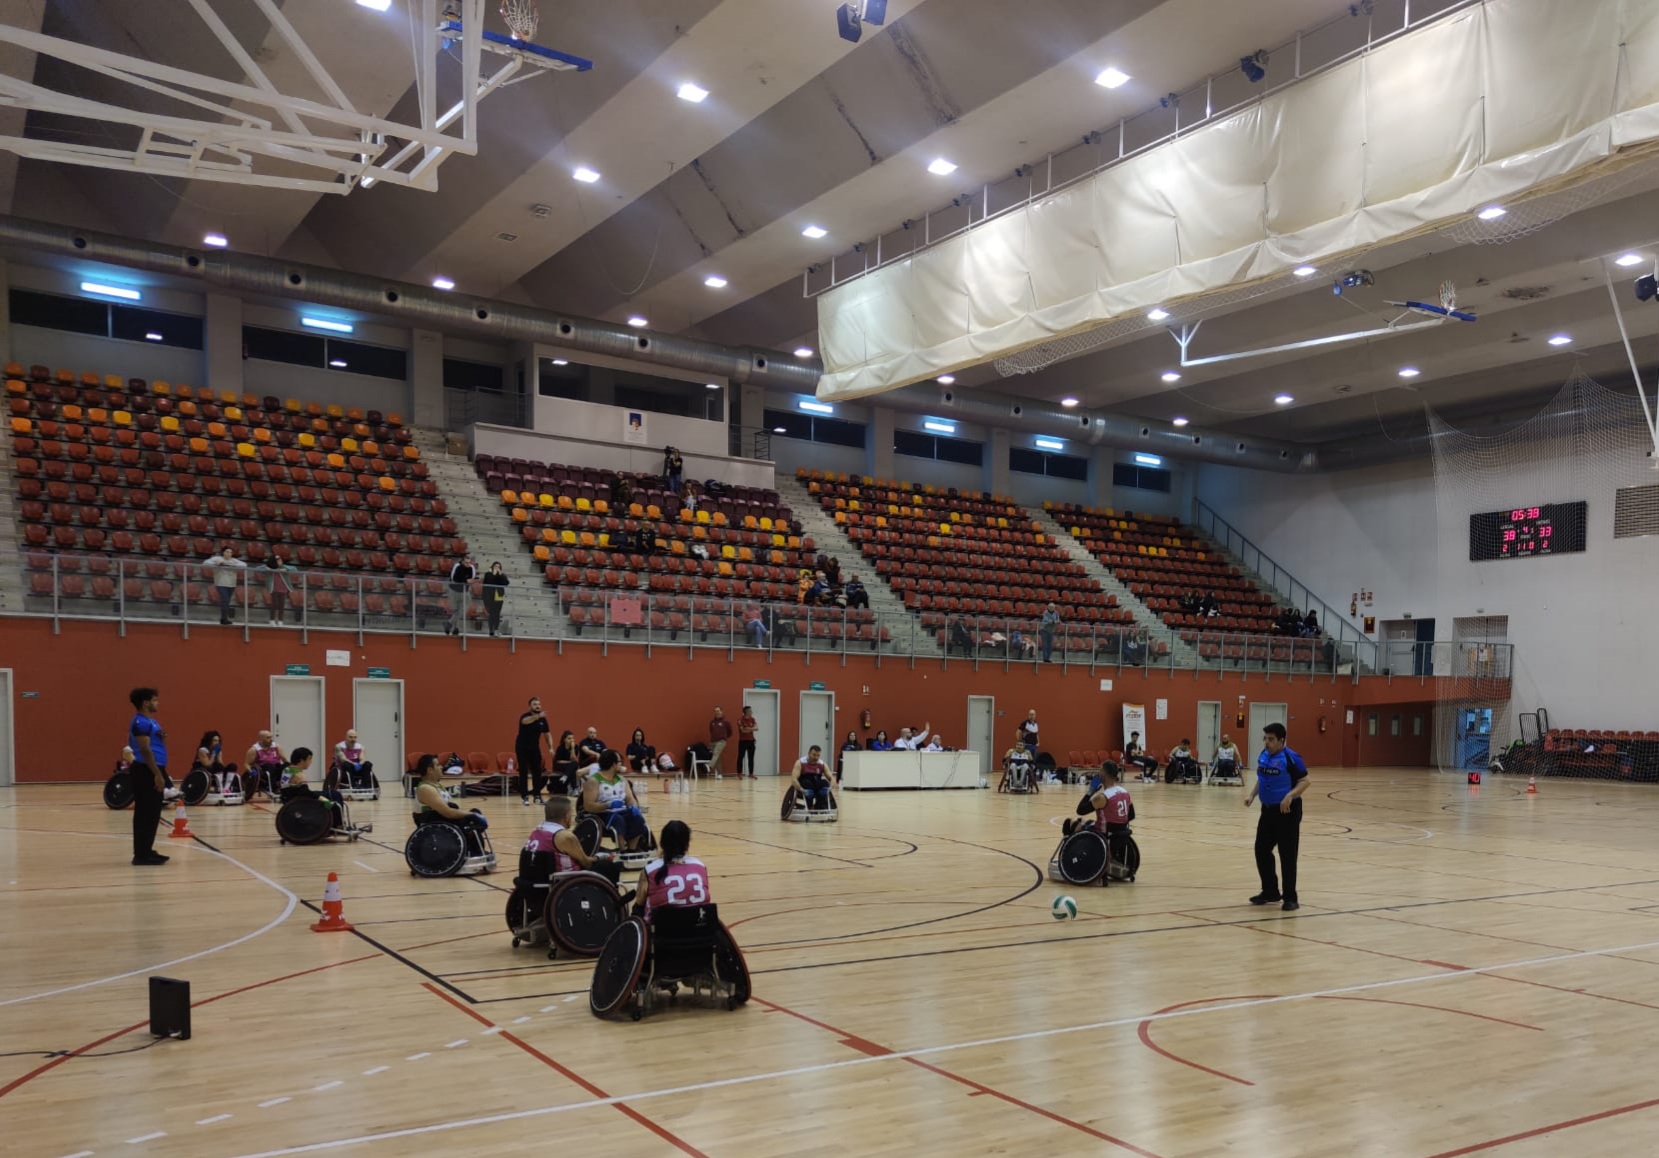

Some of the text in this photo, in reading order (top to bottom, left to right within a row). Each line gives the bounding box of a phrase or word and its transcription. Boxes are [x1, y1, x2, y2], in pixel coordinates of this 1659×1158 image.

[1539, 526, 1552, 537] 33
[1117, 799, 1127, 817] 21
[664, 873, 706, 905] 23
